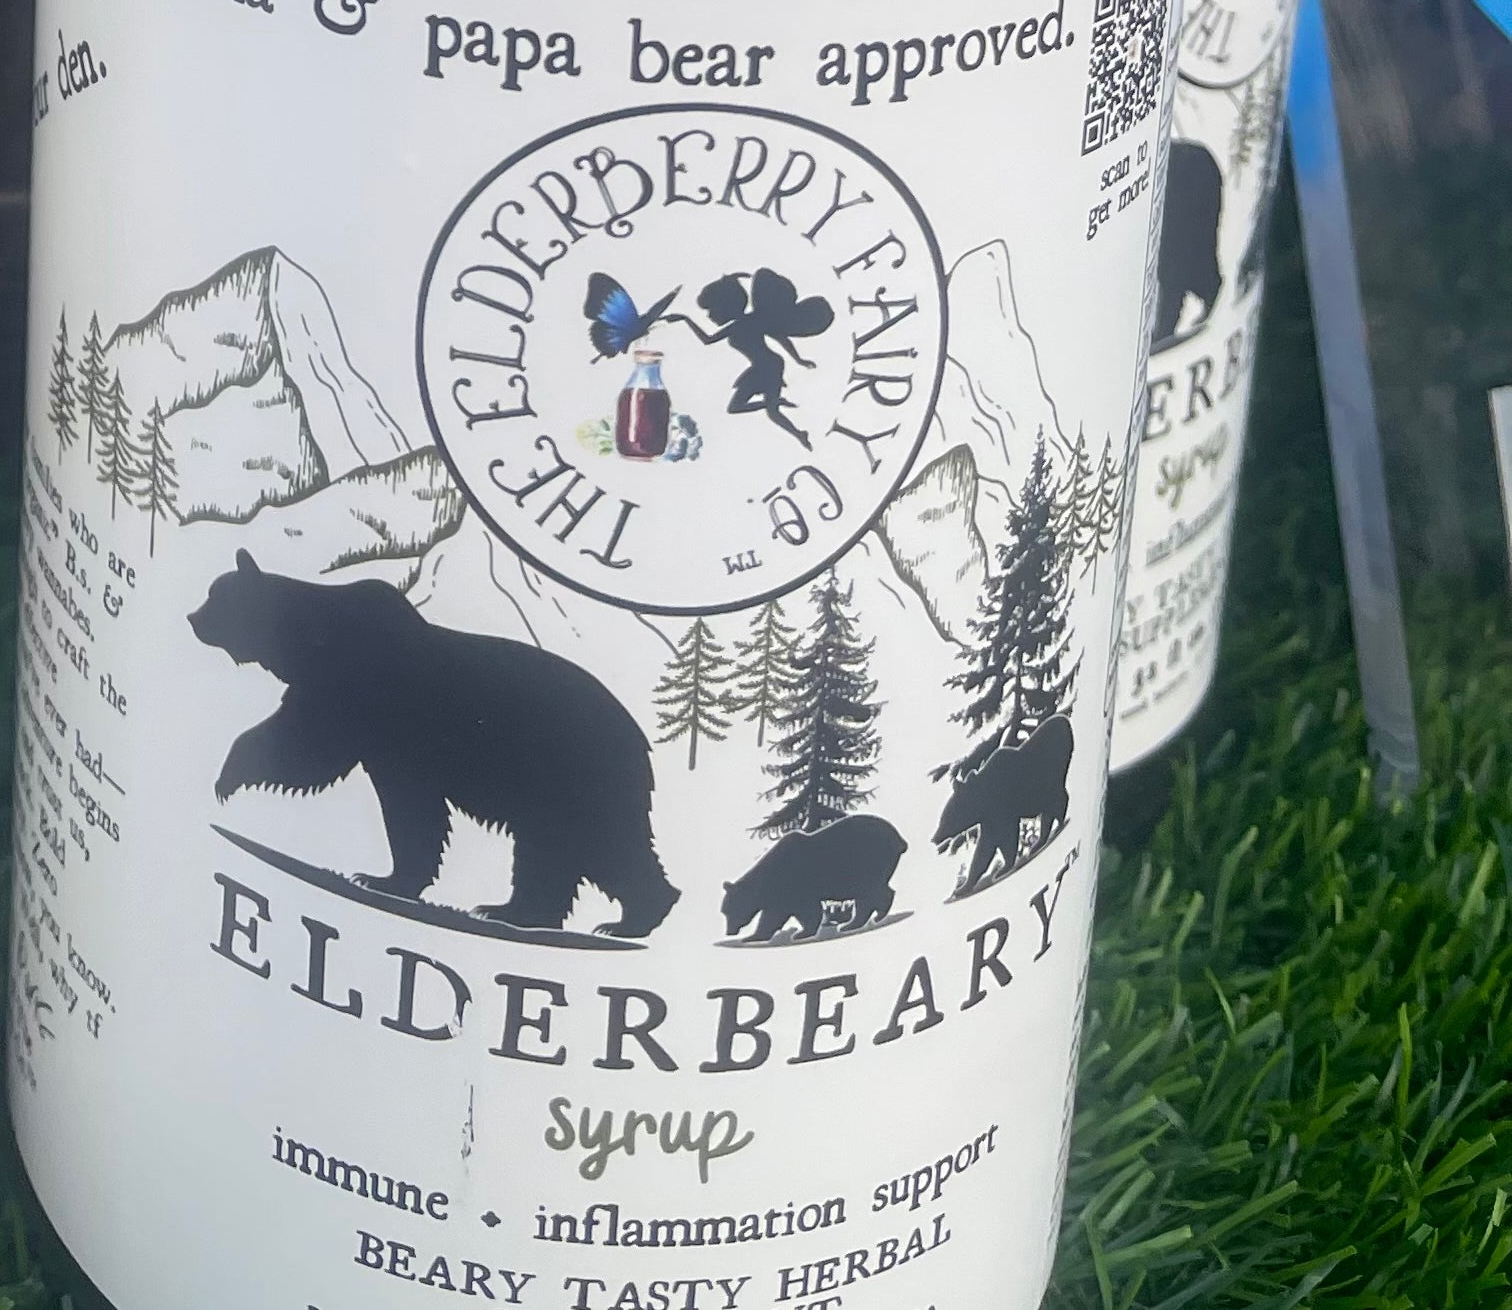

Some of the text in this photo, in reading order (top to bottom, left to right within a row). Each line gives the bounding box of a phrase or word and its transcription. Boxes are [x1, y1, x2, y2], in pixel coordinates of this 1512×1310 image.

[57, 29, 108, 101] den.
[423, 13, 582, 93] papa
[628, 17, 775, 87] bear
[1086, 155, 1152, 242] get more!
[1100, 139, 1148, 192] scan to
[449, 128, 874, 432] ELDERBERRY
[831, 229, 920, 475] FAIRY
[488, 434, 641, 570] THE
[68, 508, 136, 589] who are
[103, 584, 124, 618] &
[57, 626, 90, 680] craft
[99, 672, 127, 717] the
[68, 762, 120, 843] begins
[209, 869, 1066, 1074] ELDERBEARY
[544, 1097, 755, 1184] syrup
[272, 1123, 999, 1248] immune inflammation support
[354, 1213, 952, 1310] BEARY TASTY HERBAL
